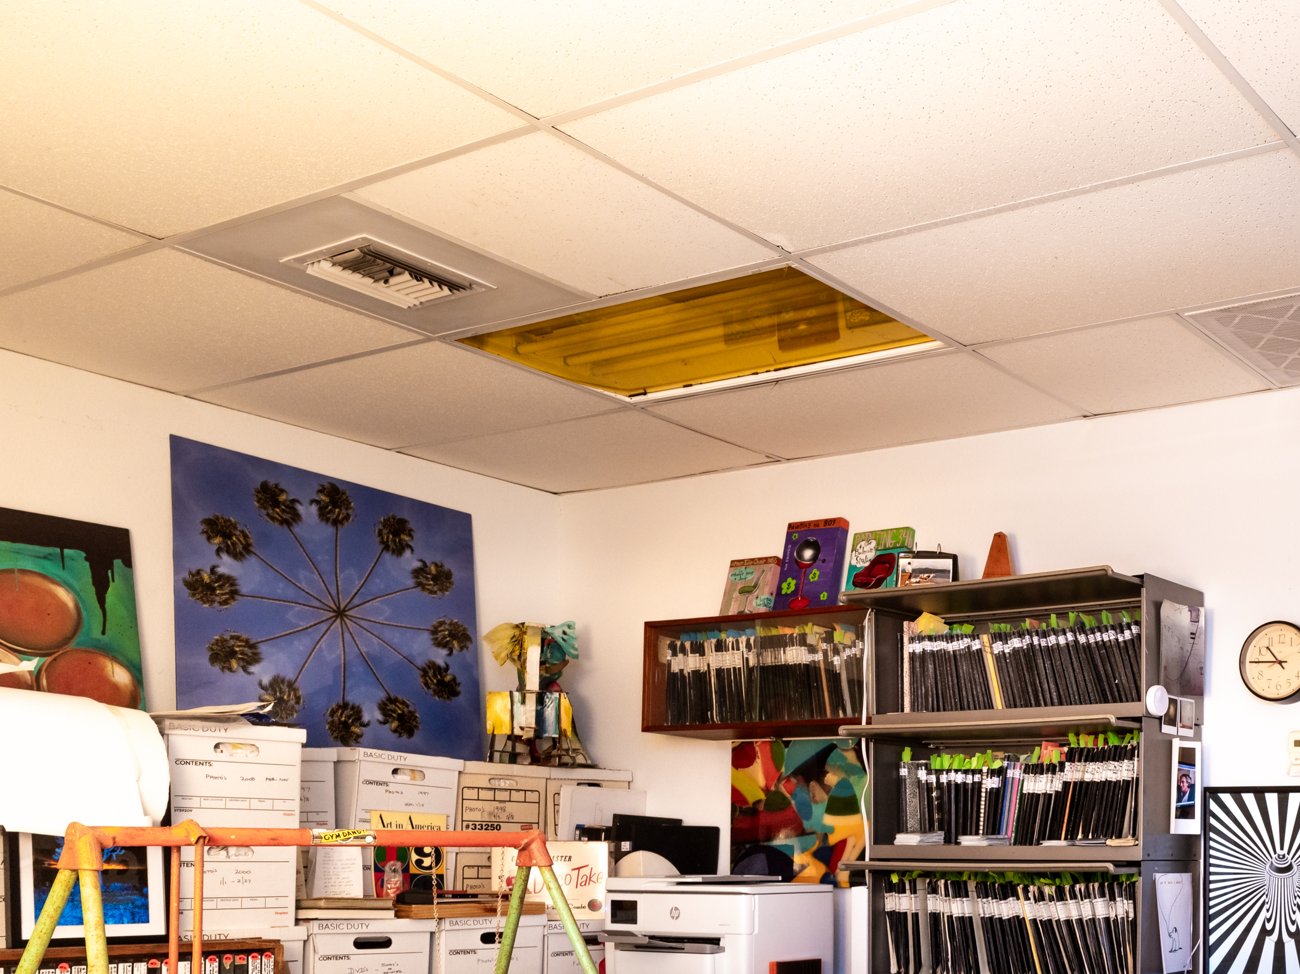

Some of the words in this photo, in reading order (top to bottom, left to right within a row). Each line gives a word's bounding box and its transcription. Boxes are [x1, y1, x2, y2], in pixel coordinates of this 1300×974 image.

[363, 751, 386, 760] BASIC
[387, 753, 408, 761] DUTY
[376, 813, 392, 829] Art
[395, 820, 404, 829] in
[406, 815, 441, 831] America
[465, 823, 502, 831] #33250
[323, 831, 341, 841] GYM
[669, 906, 681, 920] hp
[318, 922, 344, 930] BASIC
[346, 922, 370, 930] DUTY
[448, 919, 471, 927] BASIC
[472, 918, 492, 926] DUTY
